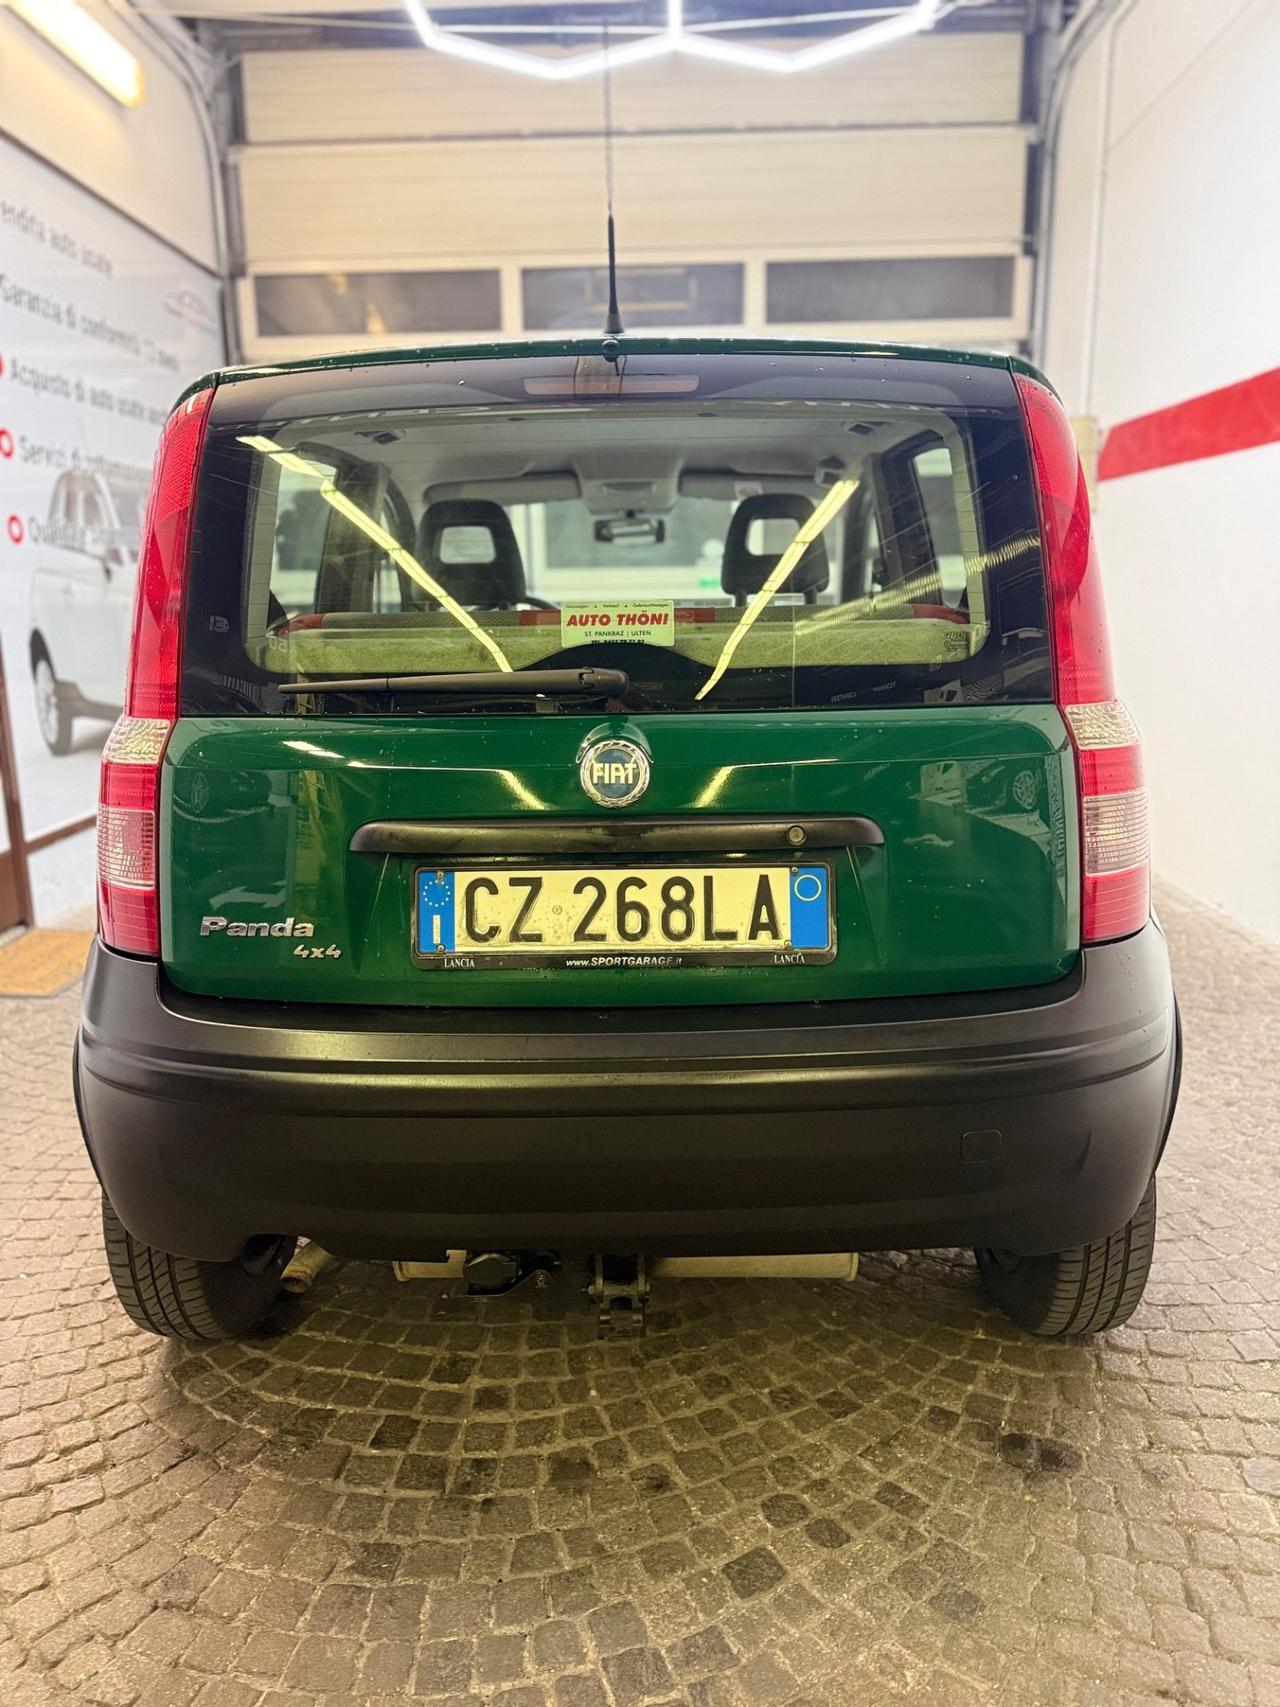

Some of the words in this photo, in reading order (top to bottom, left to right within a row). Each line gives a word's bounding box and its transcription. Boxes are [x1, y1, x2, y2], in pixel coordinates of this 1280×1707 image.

[566, 614, 611, 627] AUTO
[616, 609, 669, 625] THÖNI
[593, 762, 637, 784] FIAT
[465, 876, 543, 944] CZ
[572, 874, 782, 943] 268LA
[200, 916, 315, 937] Panda
[293, 944, 342, 959] 4x4
[774, 954, 806, 964] LANCIA
[443, 957, 475, 968] LANCIA
